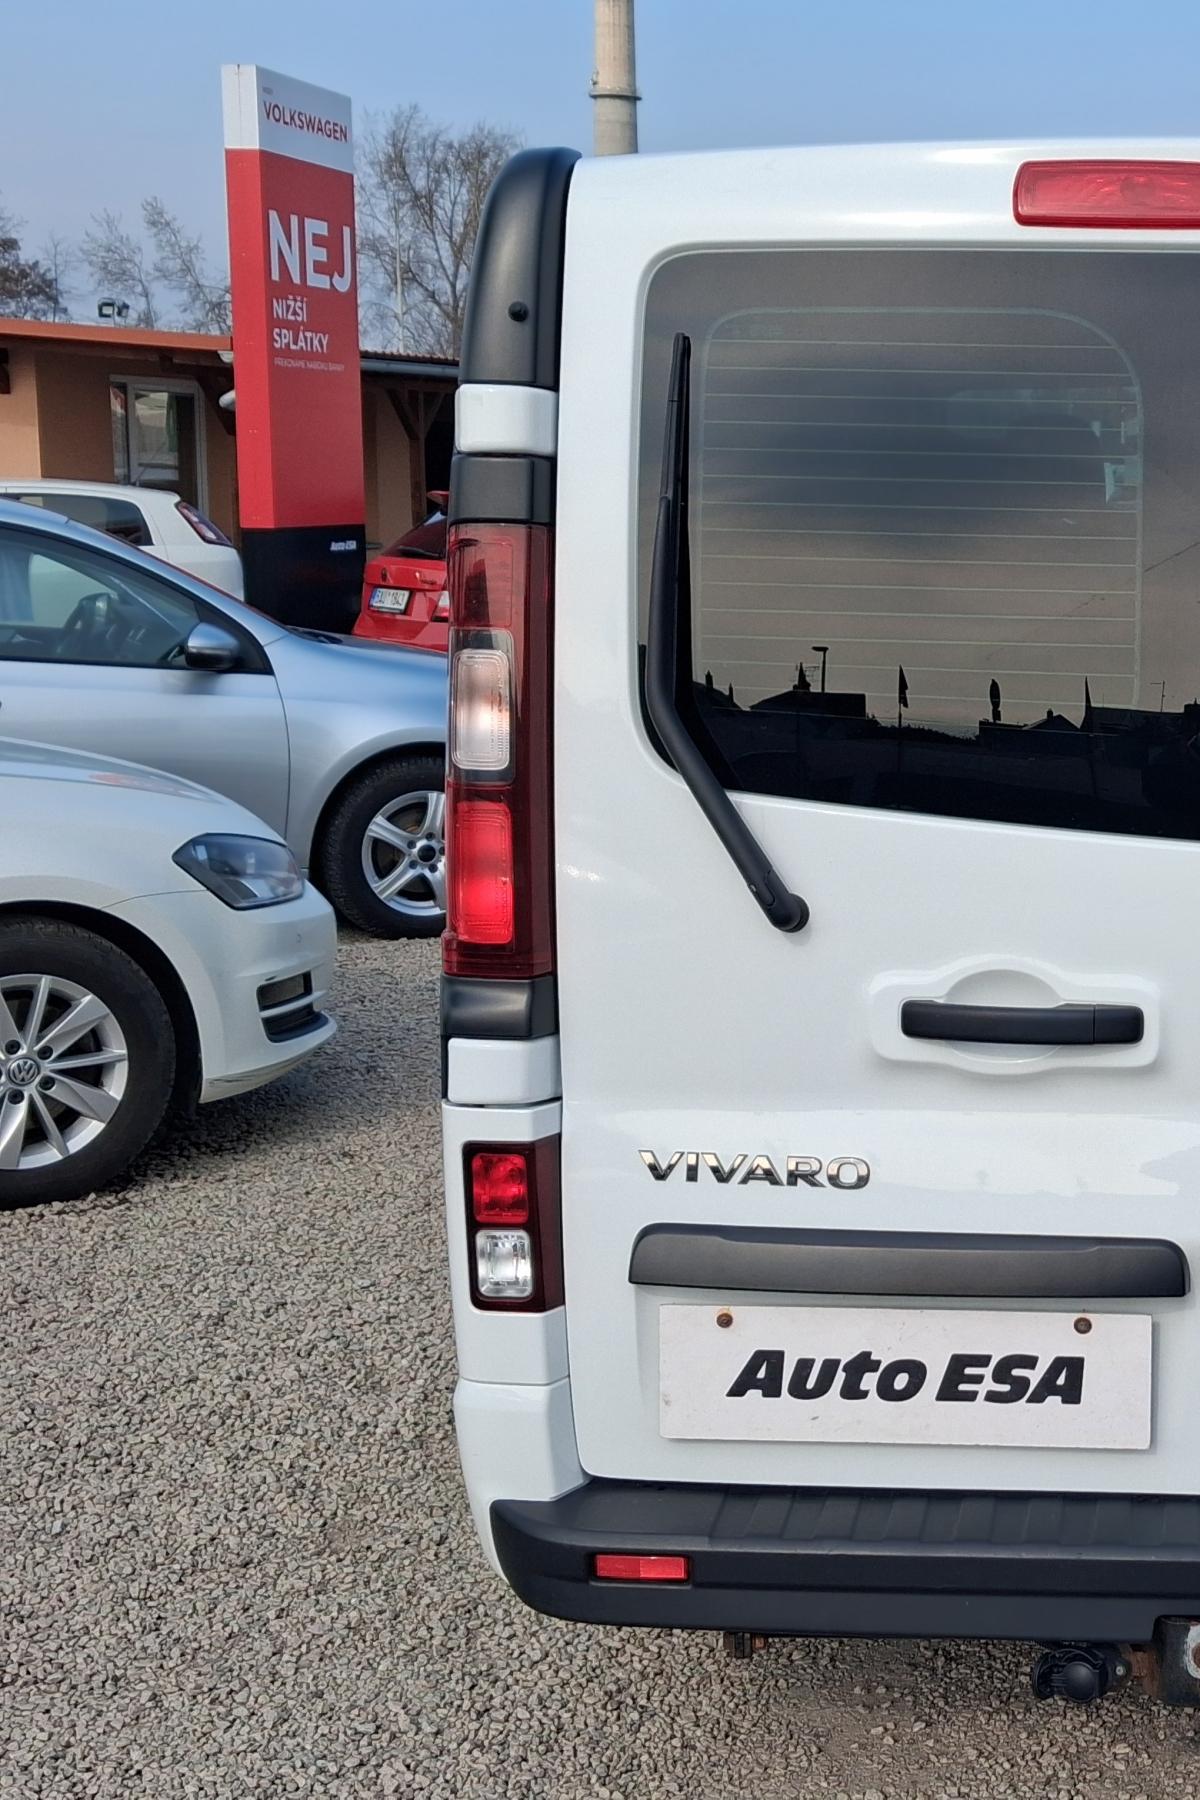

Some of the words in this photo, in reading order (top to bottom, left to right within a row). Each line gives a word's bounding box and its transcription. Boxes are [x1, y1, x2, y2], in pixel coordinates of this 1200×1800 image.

[263, 100, 348, 144] VOLKSWAGEN
[268, 208, 351, 293] NEJ
[272, 294, 308, 324] NIŽŠÍ
[272, 325, 329, 354] SPLÁTKY
[638, 1149, 871, 1191] VIVARO
[725, 1349, 928, 1402] Auto
[935, 1353, 1085, 1405] ESA
